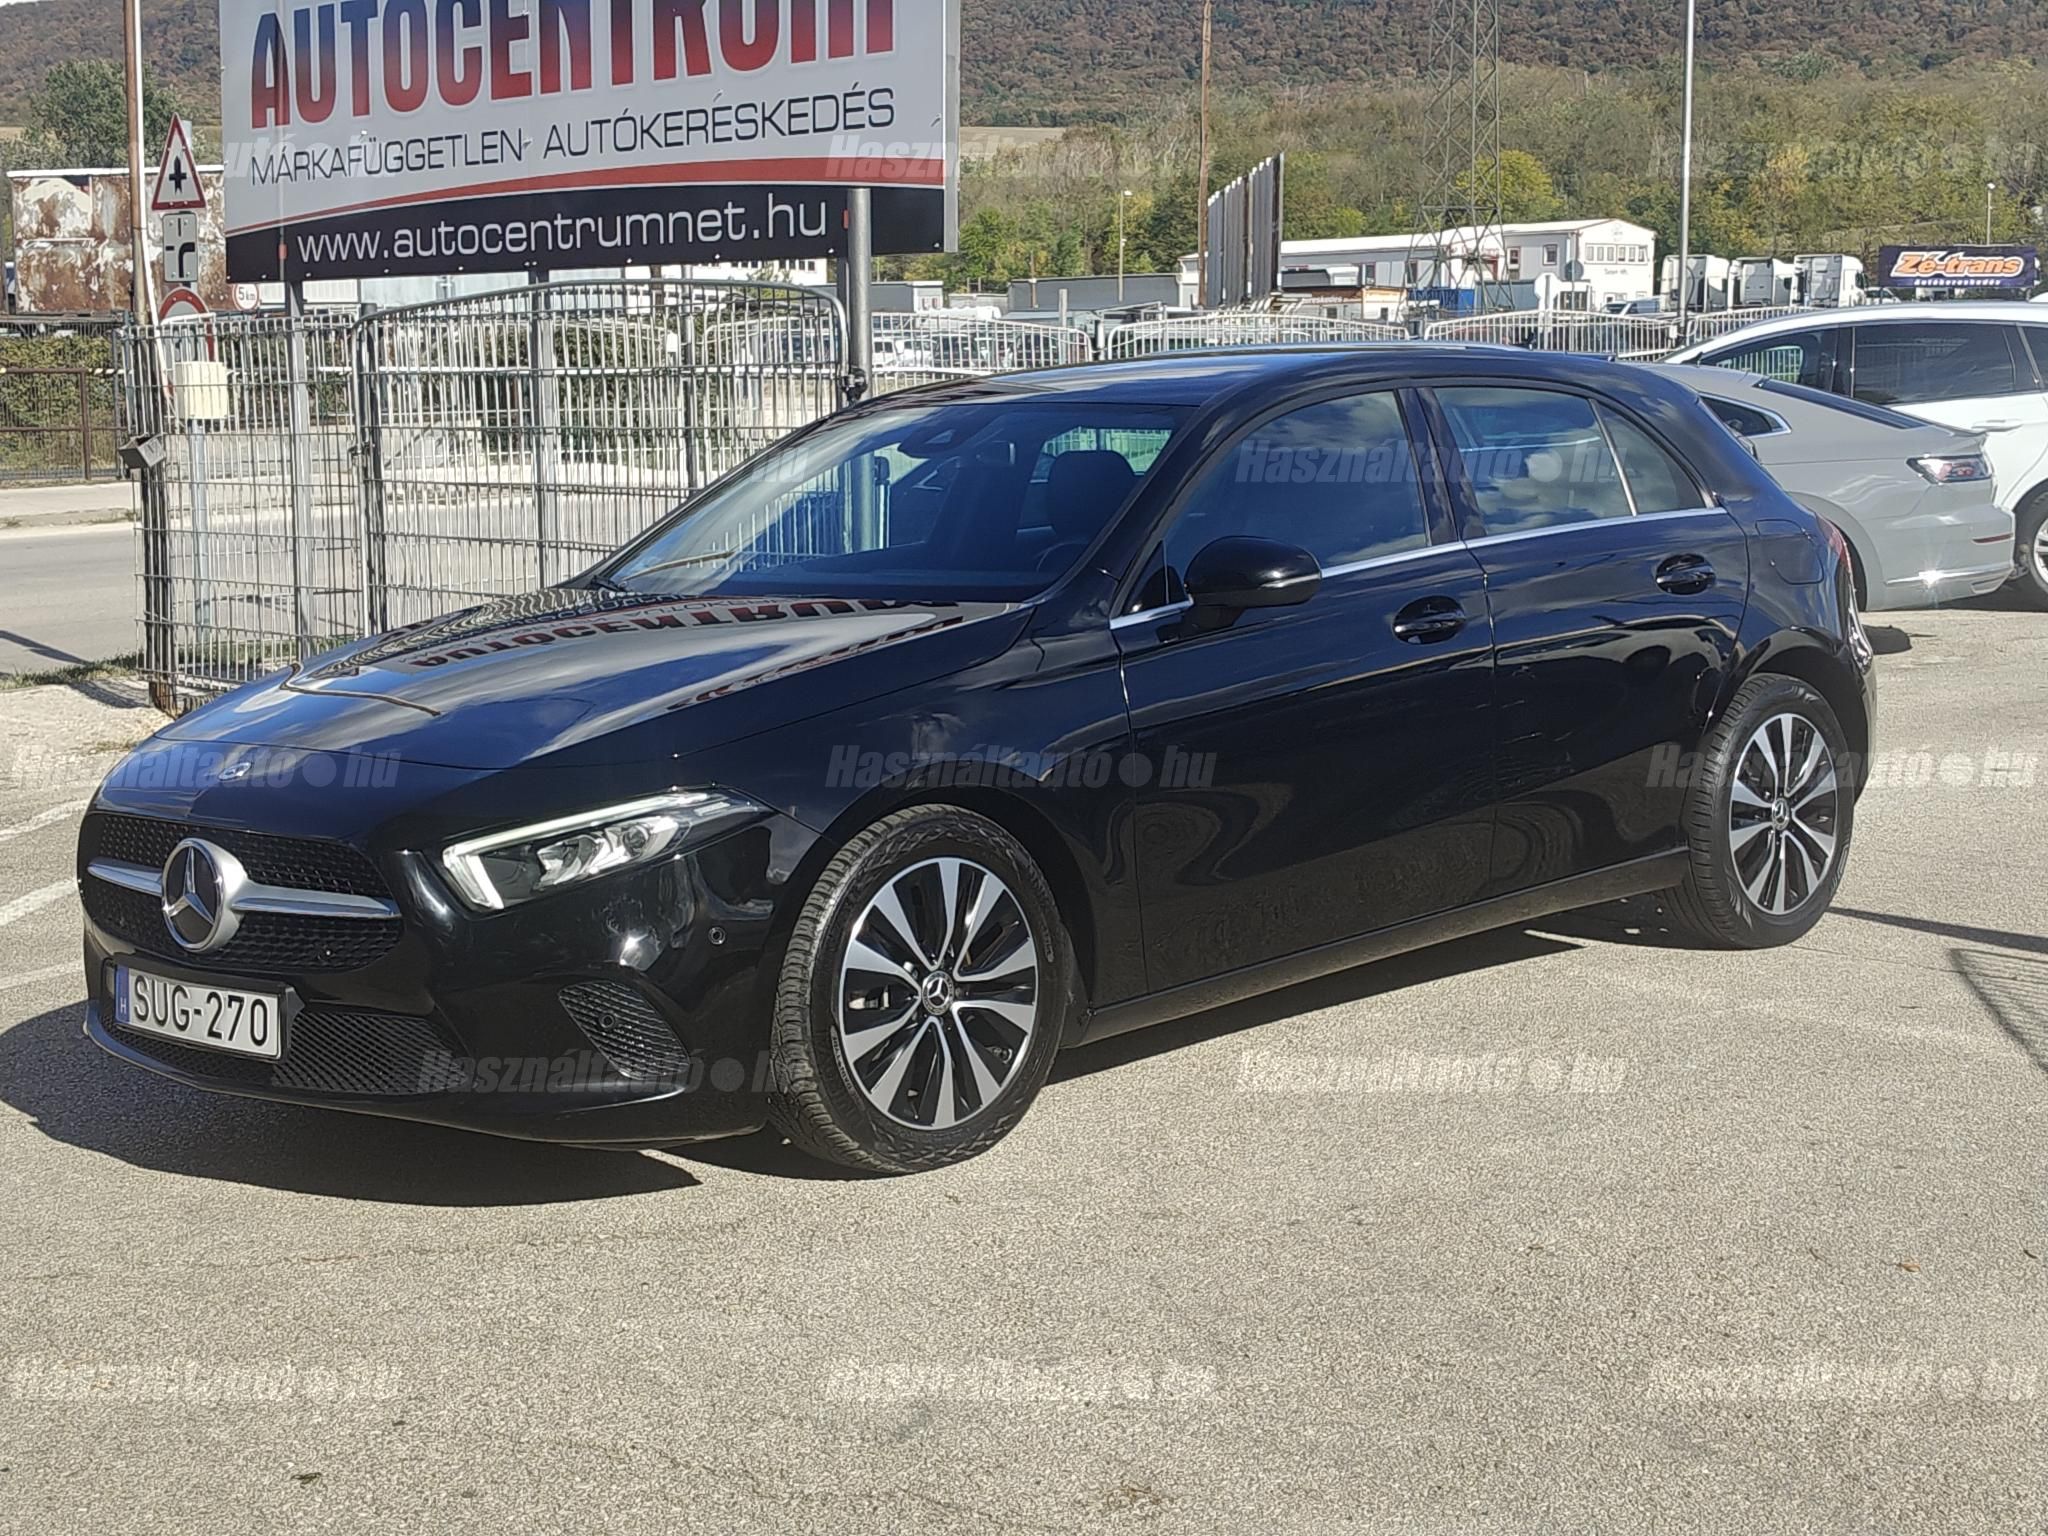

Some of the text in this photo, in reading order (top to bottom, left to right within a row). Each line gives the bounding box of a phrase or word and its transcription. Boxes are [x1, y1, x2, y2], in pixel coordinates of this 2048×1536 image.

[297, 191, 828, 264] www.autocentrumnet.hu
[238, 286, 245, 301] 5
[134, 975, 268, 1047] SUG-270
